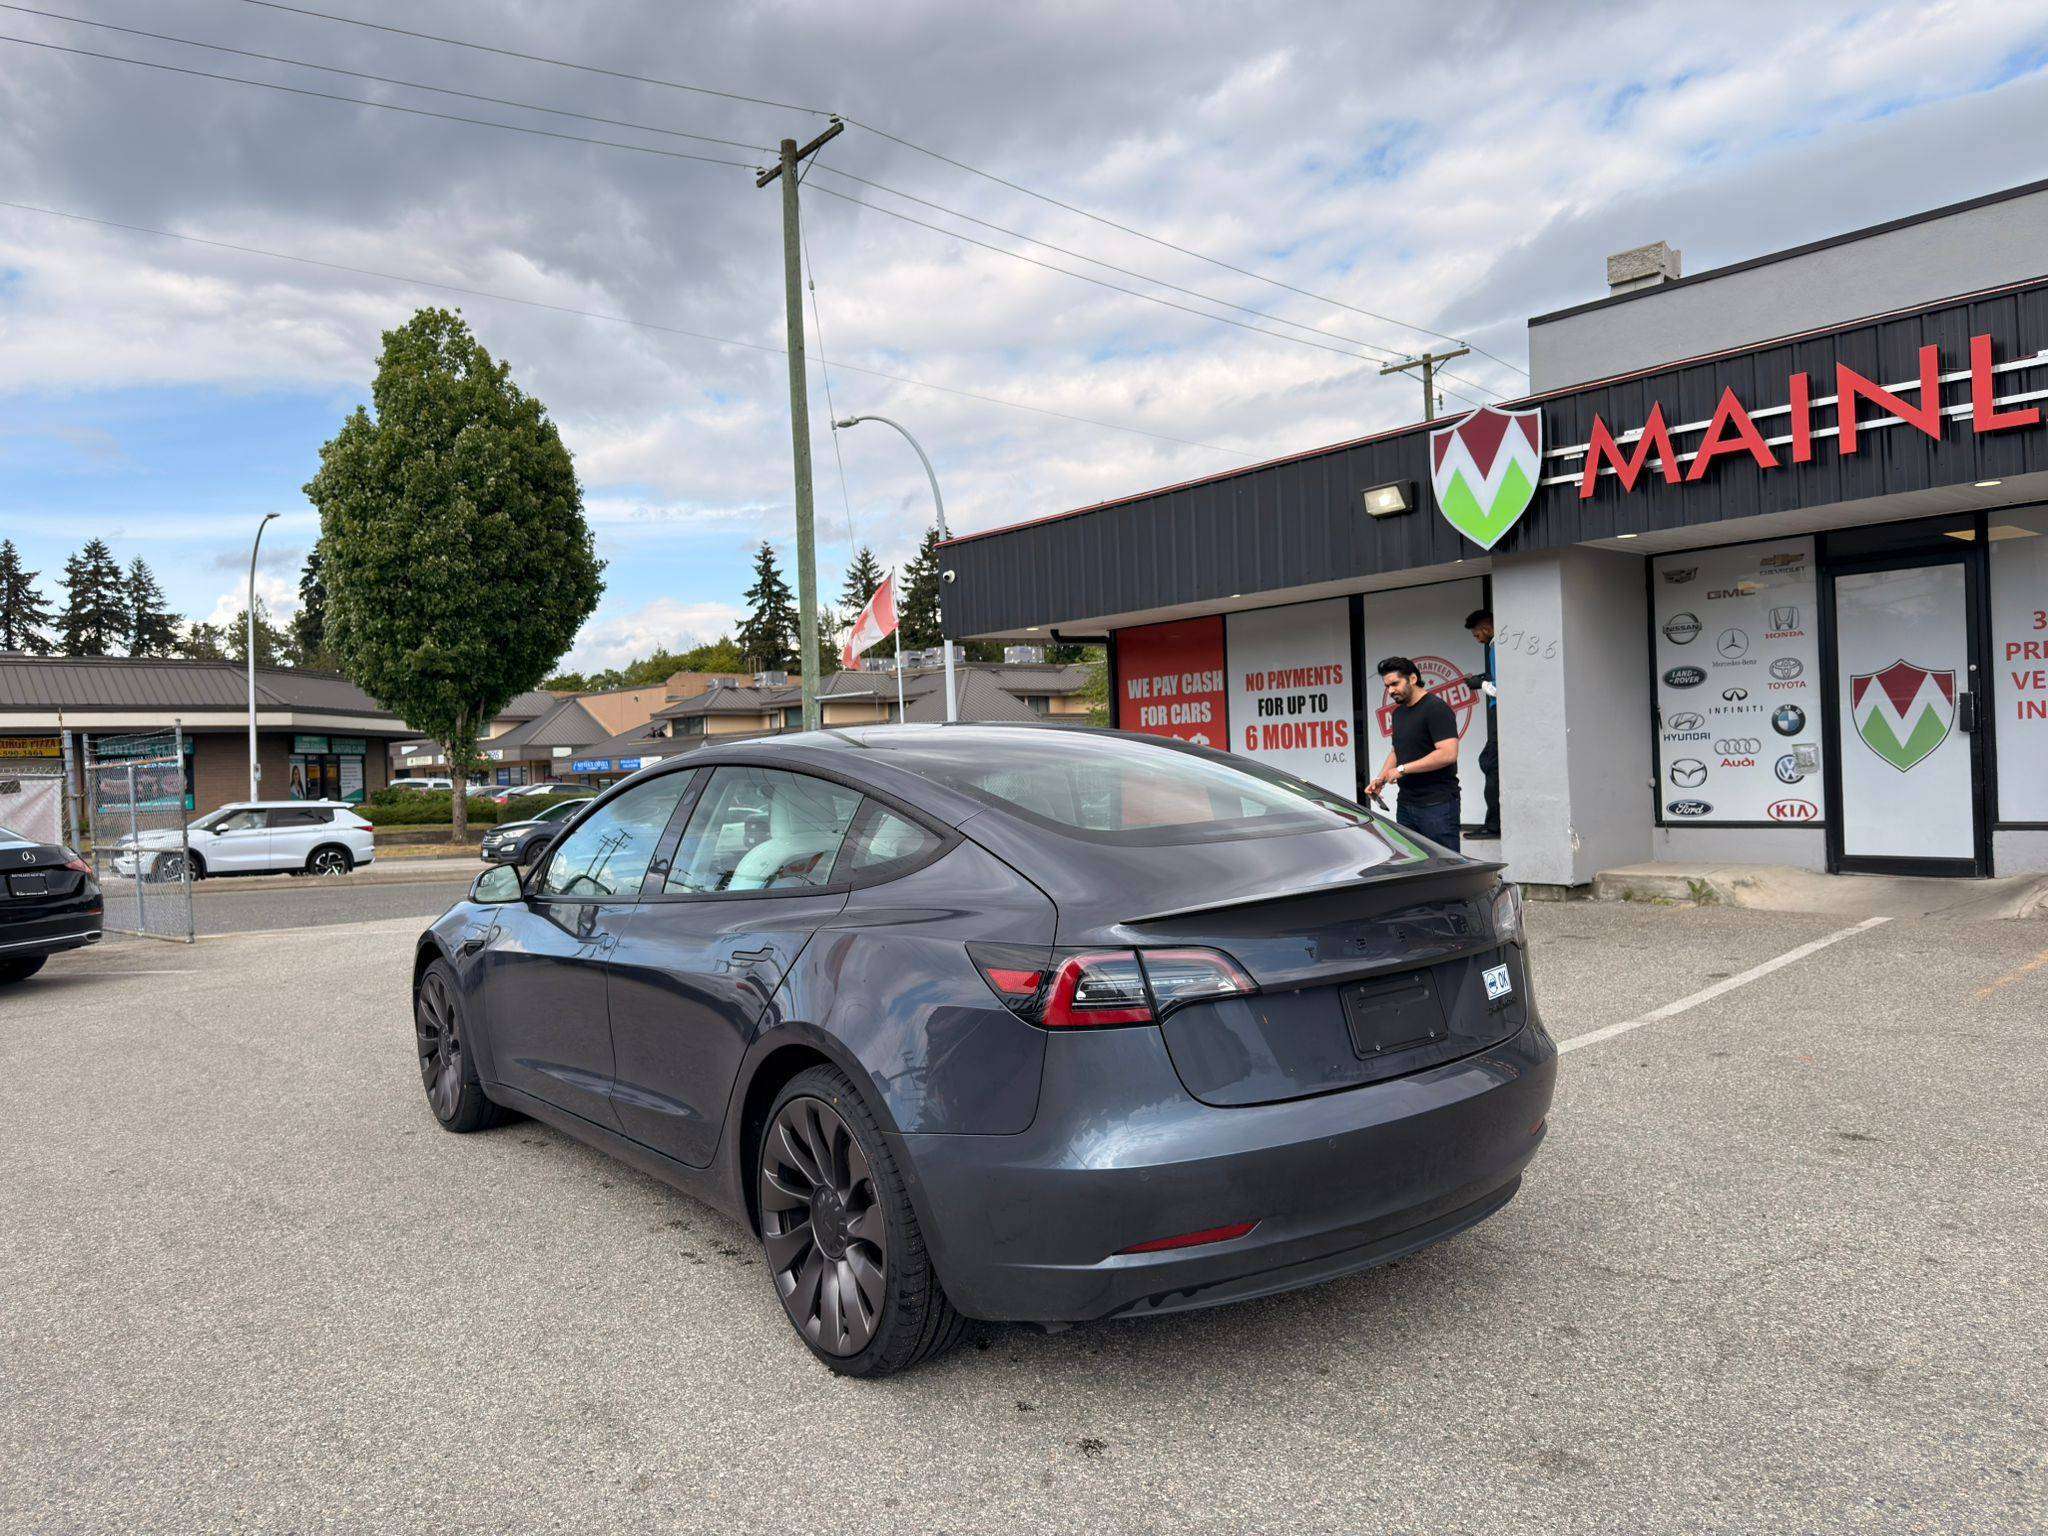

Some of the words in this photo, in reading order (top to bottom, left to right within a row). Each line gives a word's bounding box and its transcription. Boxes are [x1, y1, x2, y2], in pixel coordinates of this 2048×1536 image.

[1580, 333, 2048, 498] MAINL
[1707, 587, 1755, 600] GMC
[1666, 624, 1698, 633] NISSAN
[1498, 625, 1557, 659] 6786
[1765, 631, 1805, 640] HONDA
[1246, 672, 1265, 692] NO
[1268, 664, 1343, 690] PAYMENTS
[1672, 669, 1693, 678] LAND
[1128, 678, 1150, 699] WE
[1153, 675, 1178, 697] PAY
[1182, 670, 1223, 694] CASH
[1674, 676, 1700, 685] ROVER
[1767, 681, 1807, 690] TOYOTA
[1258, 697, 1283, 717] FOR
[1287, 695, 1306, 715] UP
[1309, 693, 1328, 713] TO
[1709, 705, 1764, 715] INFINITI
[1141, 705, 1168, 727] FOR
[1171, 701, 1212, 725] CARS
[1246, 725, 1258, 751] 6
[1263, 719, 1349, 750] MONTHS
[1663, 732, 1711, 742] HYUNDAI
[1721, 758, 1756, 768] Audi
[1675, 801, 1705, 815] Ford
[1776, 805, 1809, 818] KIA
